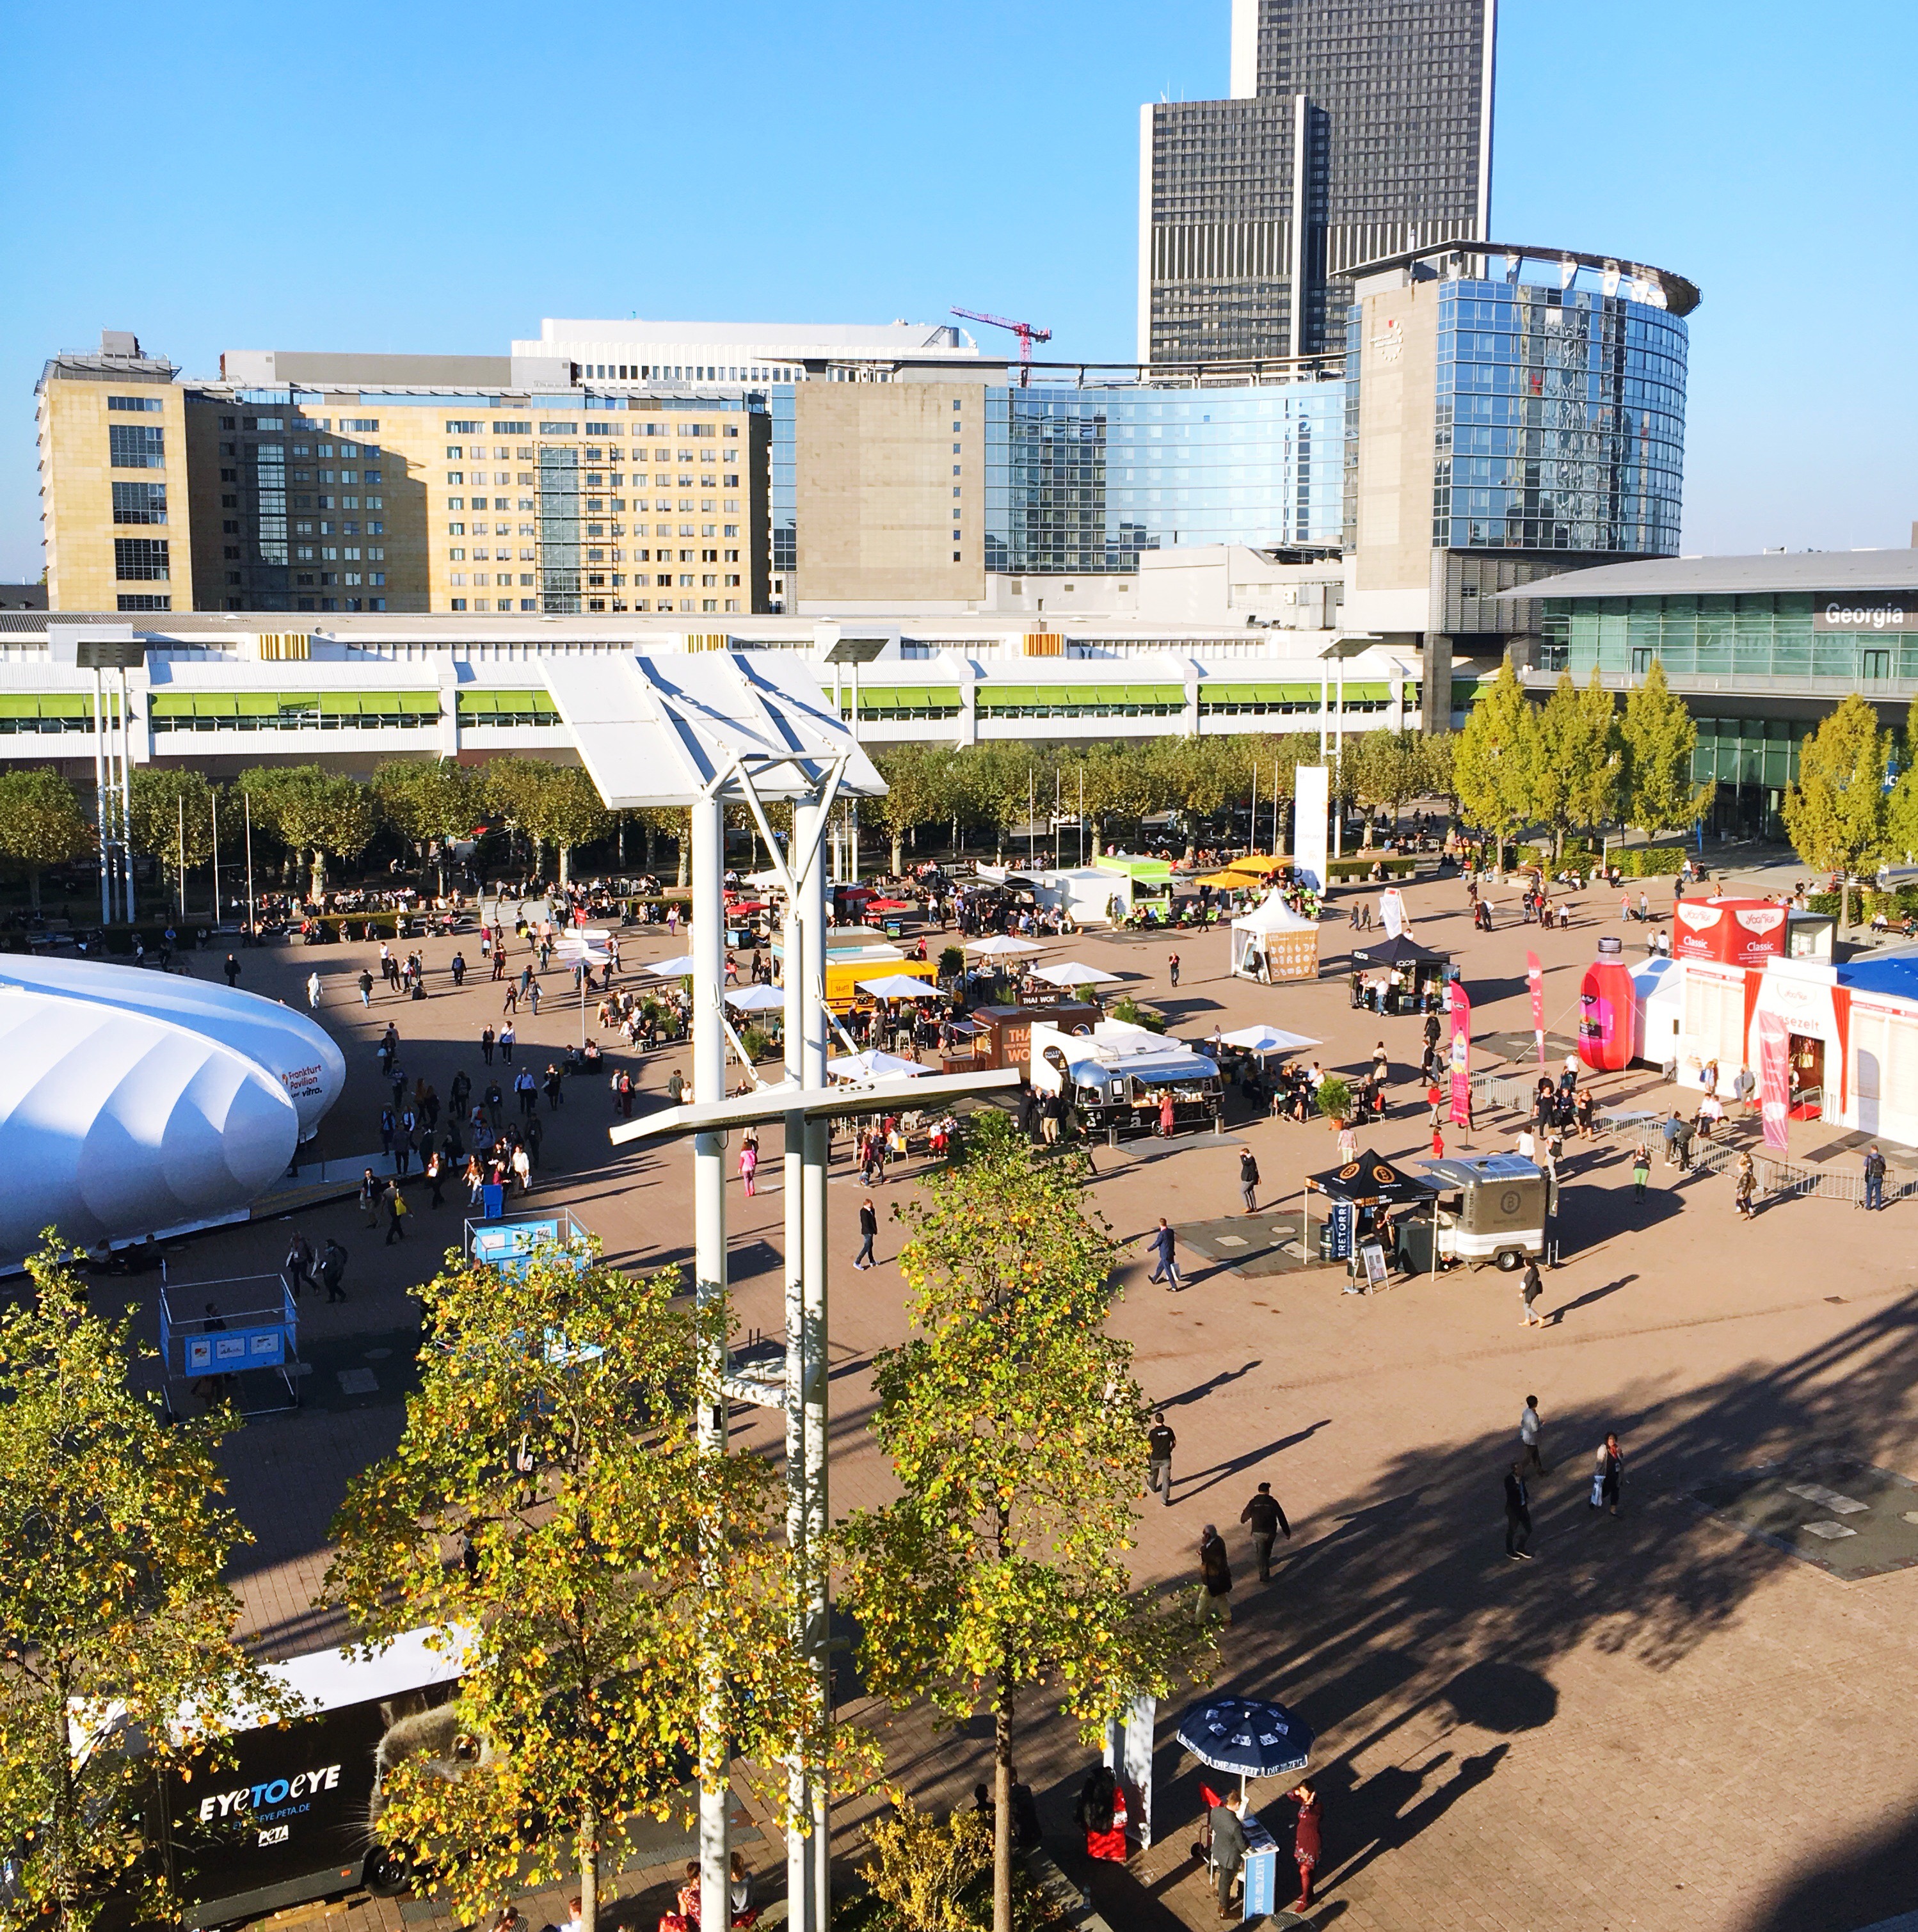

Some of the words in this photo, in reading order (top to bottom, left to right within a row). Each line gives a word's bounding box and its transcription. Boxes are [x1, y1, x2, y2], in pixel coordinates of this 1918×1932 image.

[1825, 602, 1903, 628] Georgia
[1683, 936, 1708, 949] Classic
[1746, 941, 1775, 952] Classic
[1354, 951, 1369, 961] IQOS
[1023, 996, 1038, 1005] THAI
[1040, 995, 1055, 1003] WOK
[288, 1064, 322, 1080] Frankfurt
[290, 1076, 318, 1090] Pavilion
[1212, 1759, 1230, 1770] DIE
[1239, 1765, 1259, 1776] ZEIT
[1267, 1766, 1280, 1776] DIE
[1288, 1758, 1303, 1770] ZEIT
[1256, 1858, 1265, 1882] ZEIT
[1255, 1896, 1264, 1914] DIE
